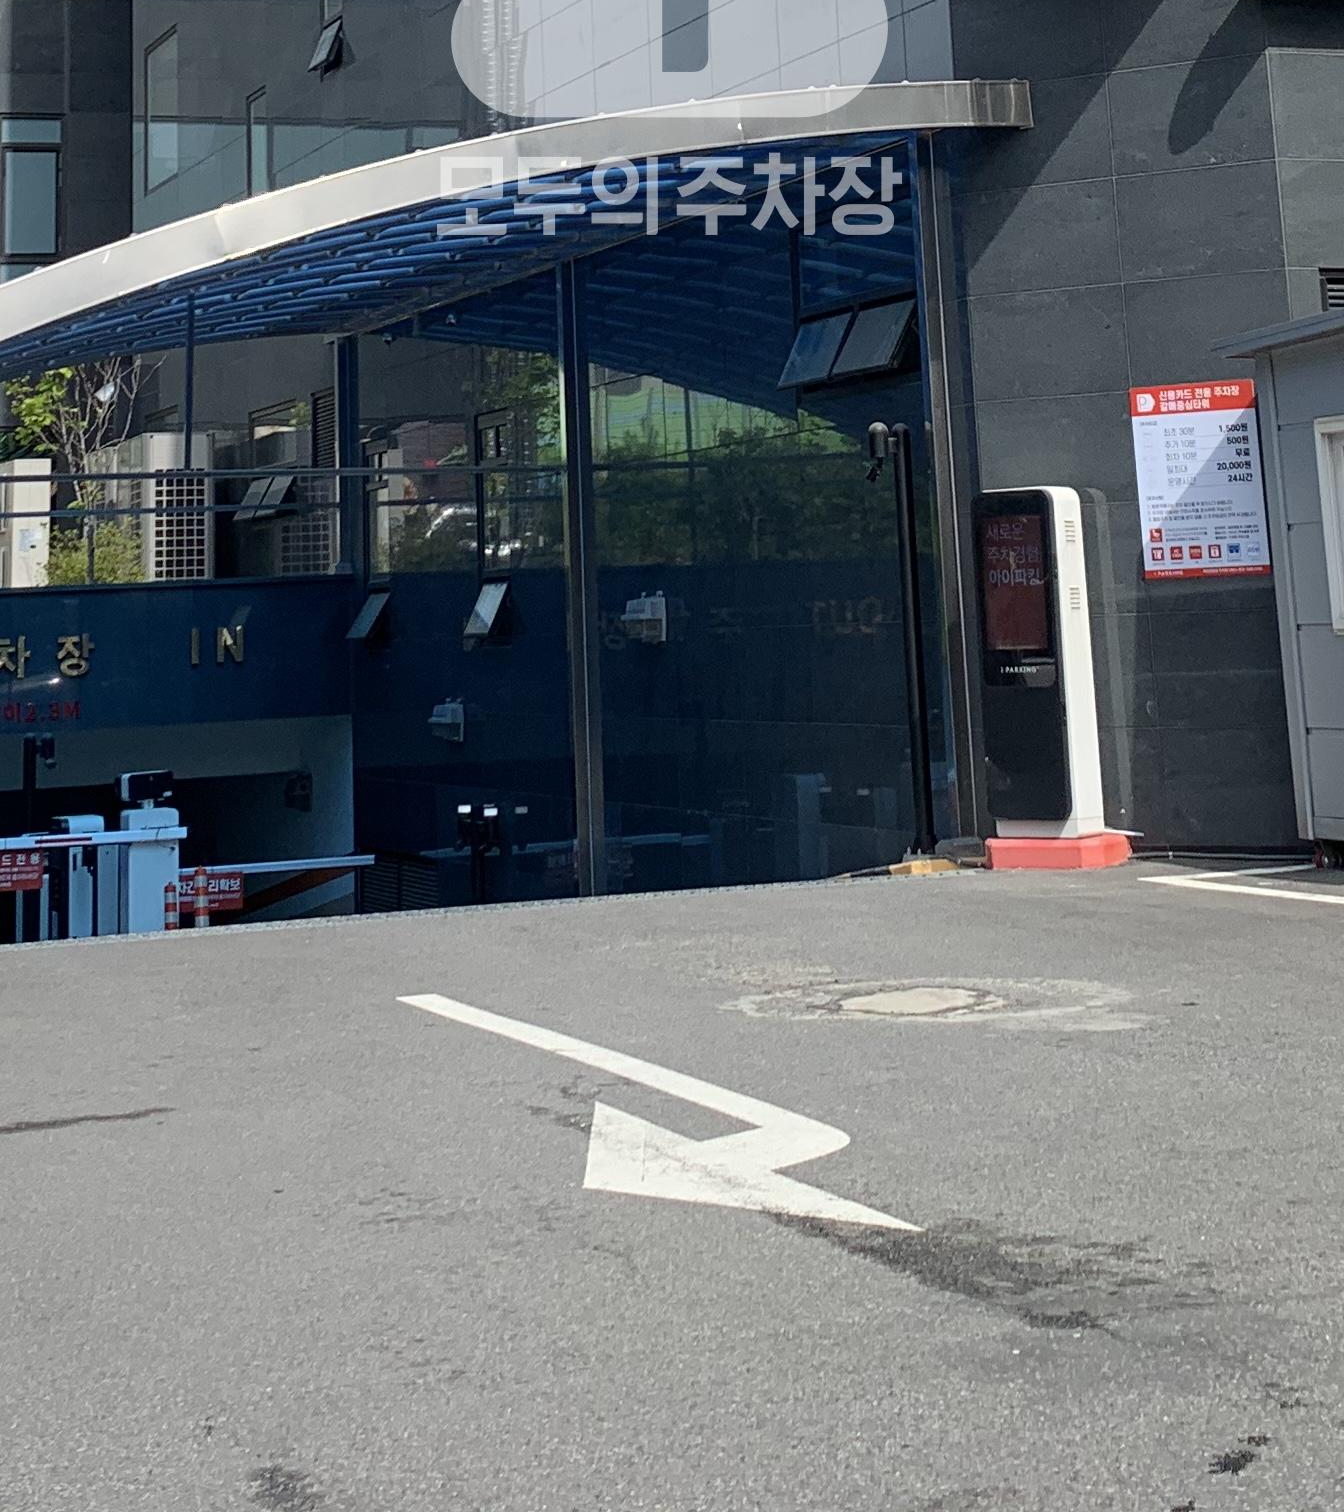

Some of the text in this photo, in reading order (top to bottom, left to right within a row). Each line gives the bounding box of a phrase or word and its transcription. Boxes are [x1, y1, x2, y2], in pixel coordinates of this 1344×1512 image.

[1159, 385, 1240, 402] 신용카드 전용 주차장
[1218, 422, 1248, 434] 1,500원
[1226, 435, 1249, 445] 500원
[1216, 461, 1252, 471] 20,000원
[1227, 473, 1253, 483] 24시간
[986, 523, 1025, 541] 새로운
[988, 568, 1044, 587] 아이파킹
[191, 624, 244, 665] IN
